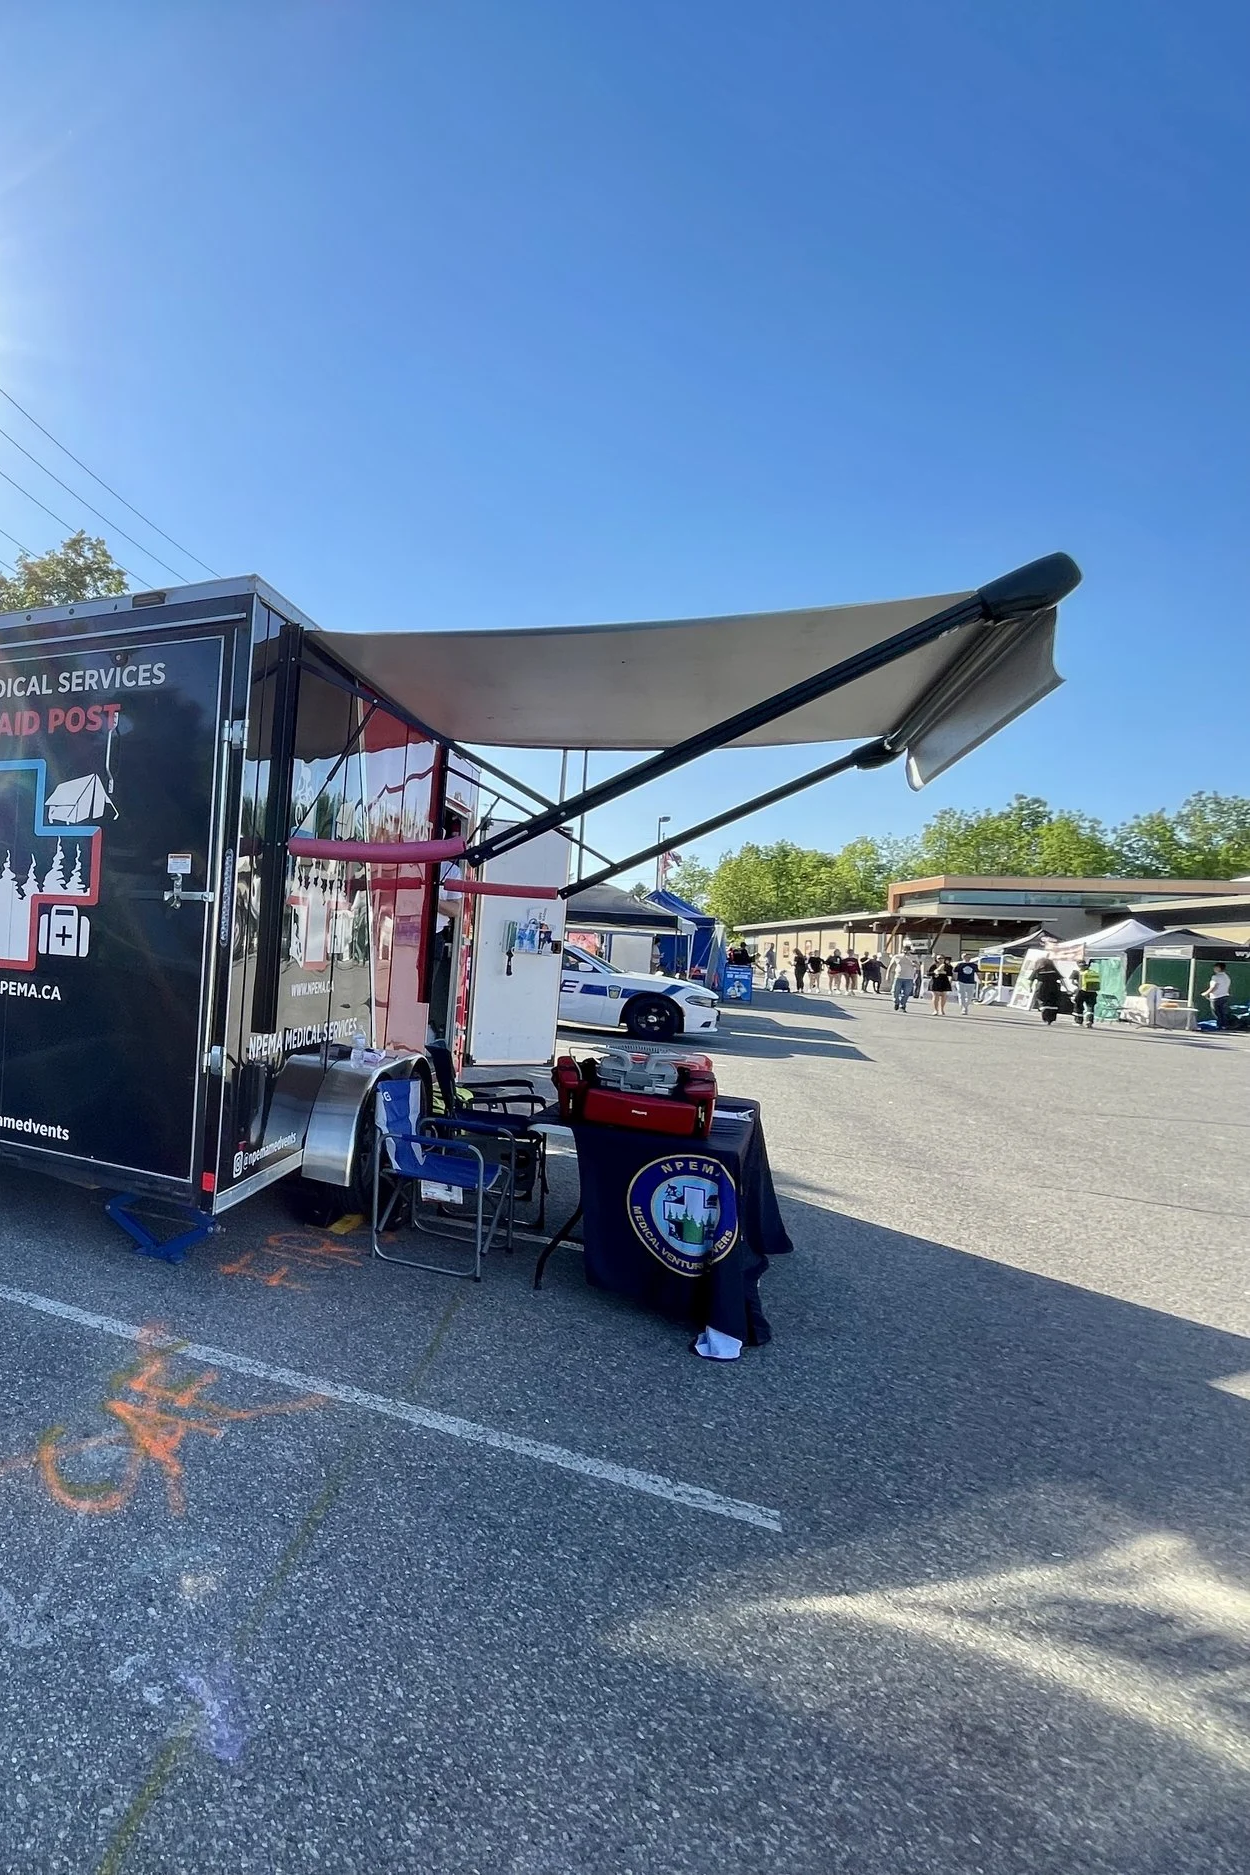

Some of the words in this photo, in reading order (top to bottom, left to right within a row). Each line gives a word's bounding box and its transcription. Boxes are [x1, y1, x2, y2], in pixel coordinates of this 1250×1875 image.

[57, 662, 166, 694] SERVICES
[47, 703, 122, 735] POST
[248, 1030, 283, 1060] NPEMA
[285, 1023, 322, 1051] MEDICAL
[322, 1017, 357, 1042] SERVICES
[632, 1205, 661, 1250] MEDICAL
